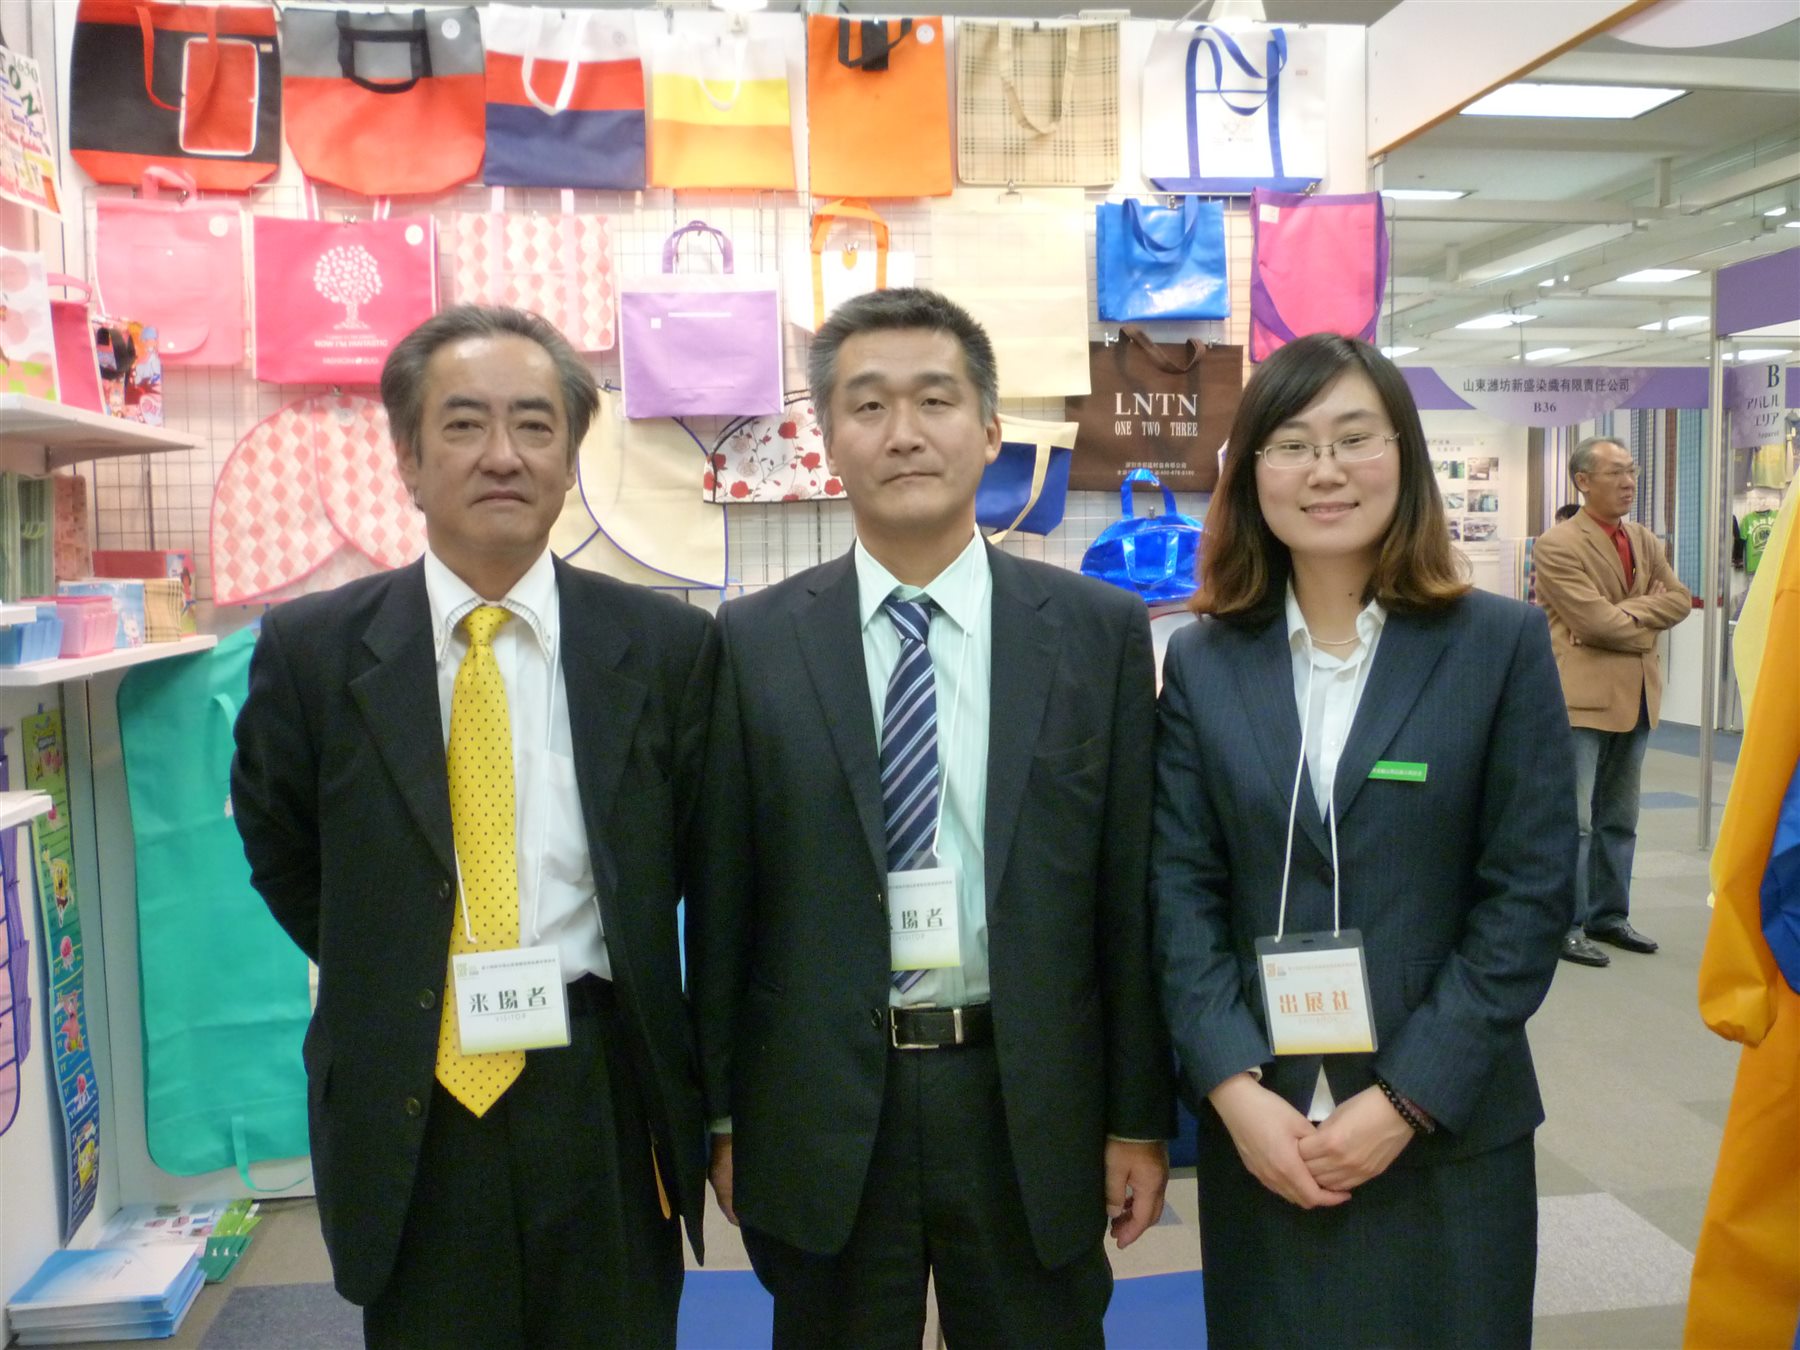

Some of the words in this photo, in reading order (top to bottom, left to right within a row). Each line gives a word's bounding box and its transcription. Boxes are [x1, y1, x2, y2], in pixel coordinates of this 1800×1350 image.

[1767, 364, 1780, 388] B
[1114, 392, 1198, 416] LNTN
[1533, 402, 1557, 413] B36
[1114, 420, 1132, 436] ONE
[1141, 421, 1161, 437] TWO
[1169, 421, 1198, 437] THREE
